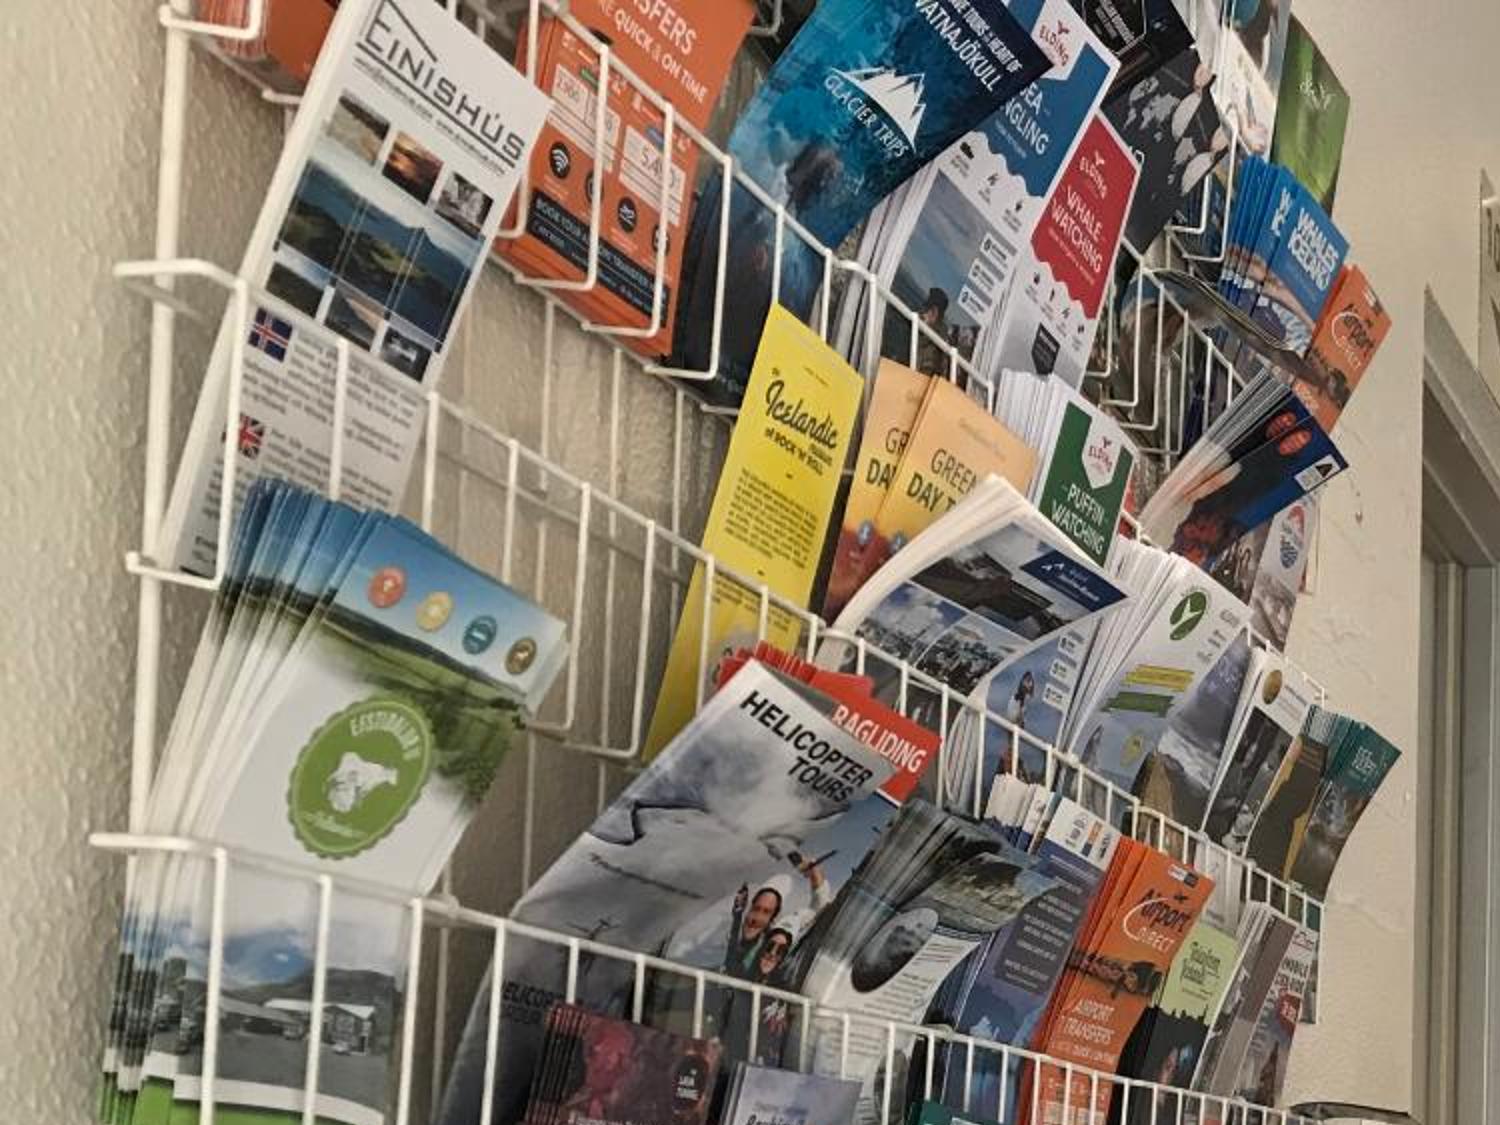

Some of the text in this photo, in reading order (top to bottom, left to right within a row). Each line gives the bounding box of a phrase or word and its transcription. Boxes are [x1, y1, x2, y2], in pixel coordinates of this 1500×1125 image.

[824, 74, 909, 158] GLACIER TRIPS
[1051, 200, 1103, 273] WATCHING
[1066, 184, 1103, 238] WHALE
[765, 379, 839, 450] Icelandic
[906, 472, 946, 513] DAY
[739, 691, 874, 788] HELICOPTER
[787, 757, 854, 803] TOURS
